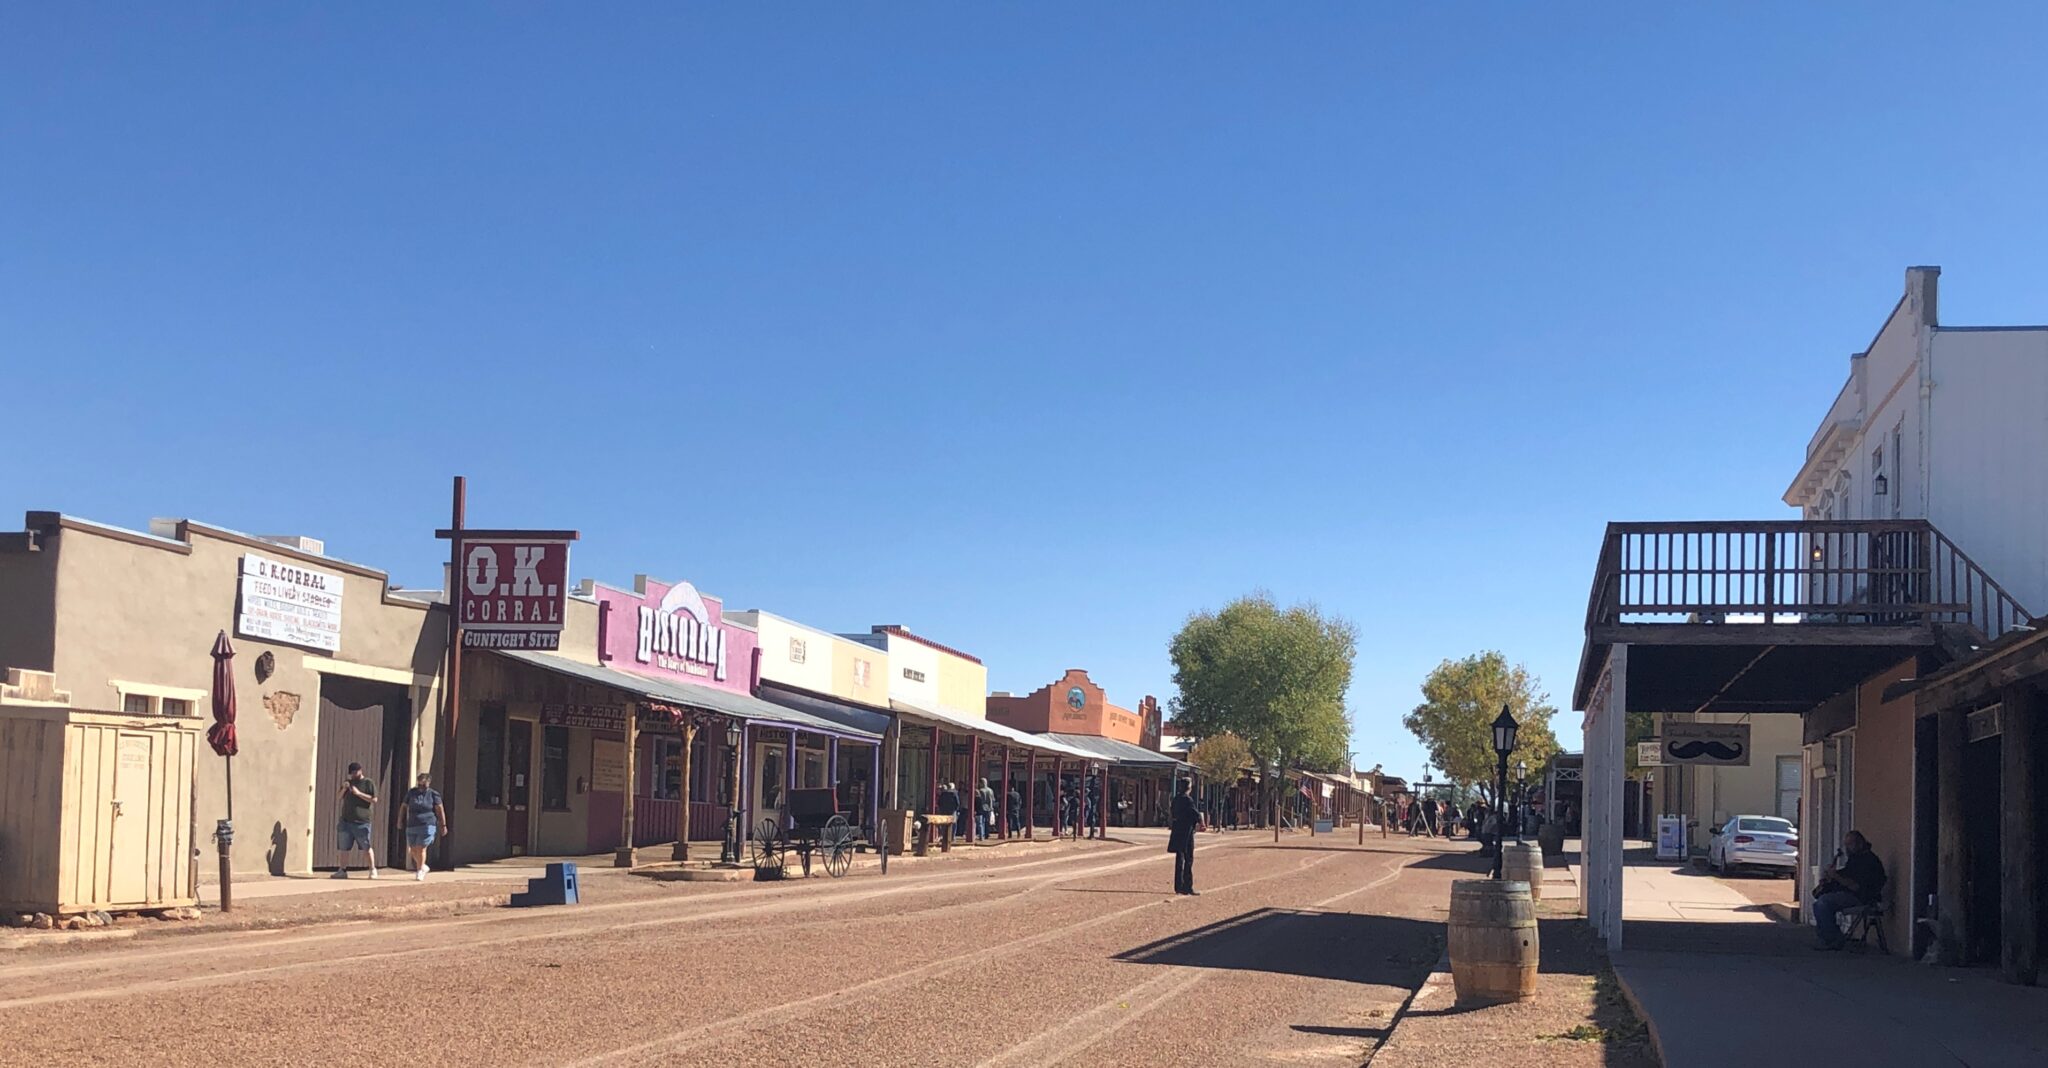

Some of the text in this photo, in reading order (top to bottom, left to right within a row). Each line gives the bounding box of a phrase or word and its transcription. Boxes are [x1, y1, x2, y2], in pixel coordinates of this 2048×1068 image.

[254, 581, 271, 595] FEED
[467, 546, 557, 596] O.K.
[467, 600, 558, 621] CORRAL
[636, 606, 726, 681] HISTORAMA
